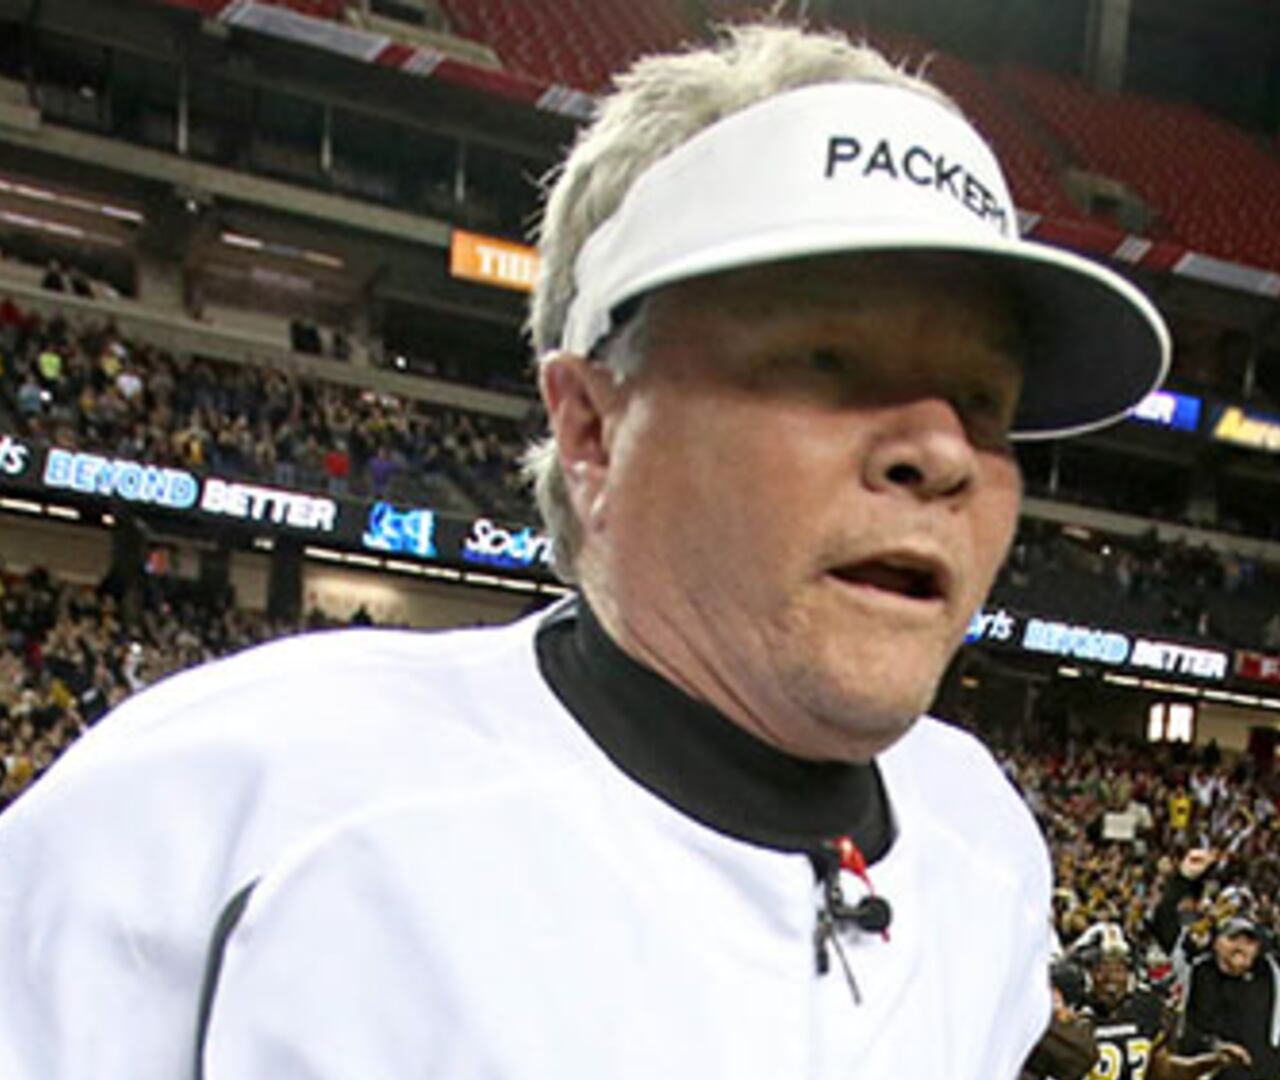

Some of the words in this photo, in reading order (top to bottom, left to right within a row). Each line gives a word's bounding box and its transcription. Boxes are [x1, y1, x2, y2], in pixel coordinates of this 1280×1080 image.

[44, 448, 199, 509] BEYOND
[201, 478, 337, 532] BETTER
[1022, 618, 1130, 665] BEYOND
[1131, 638, 1228, 681] BETTER
